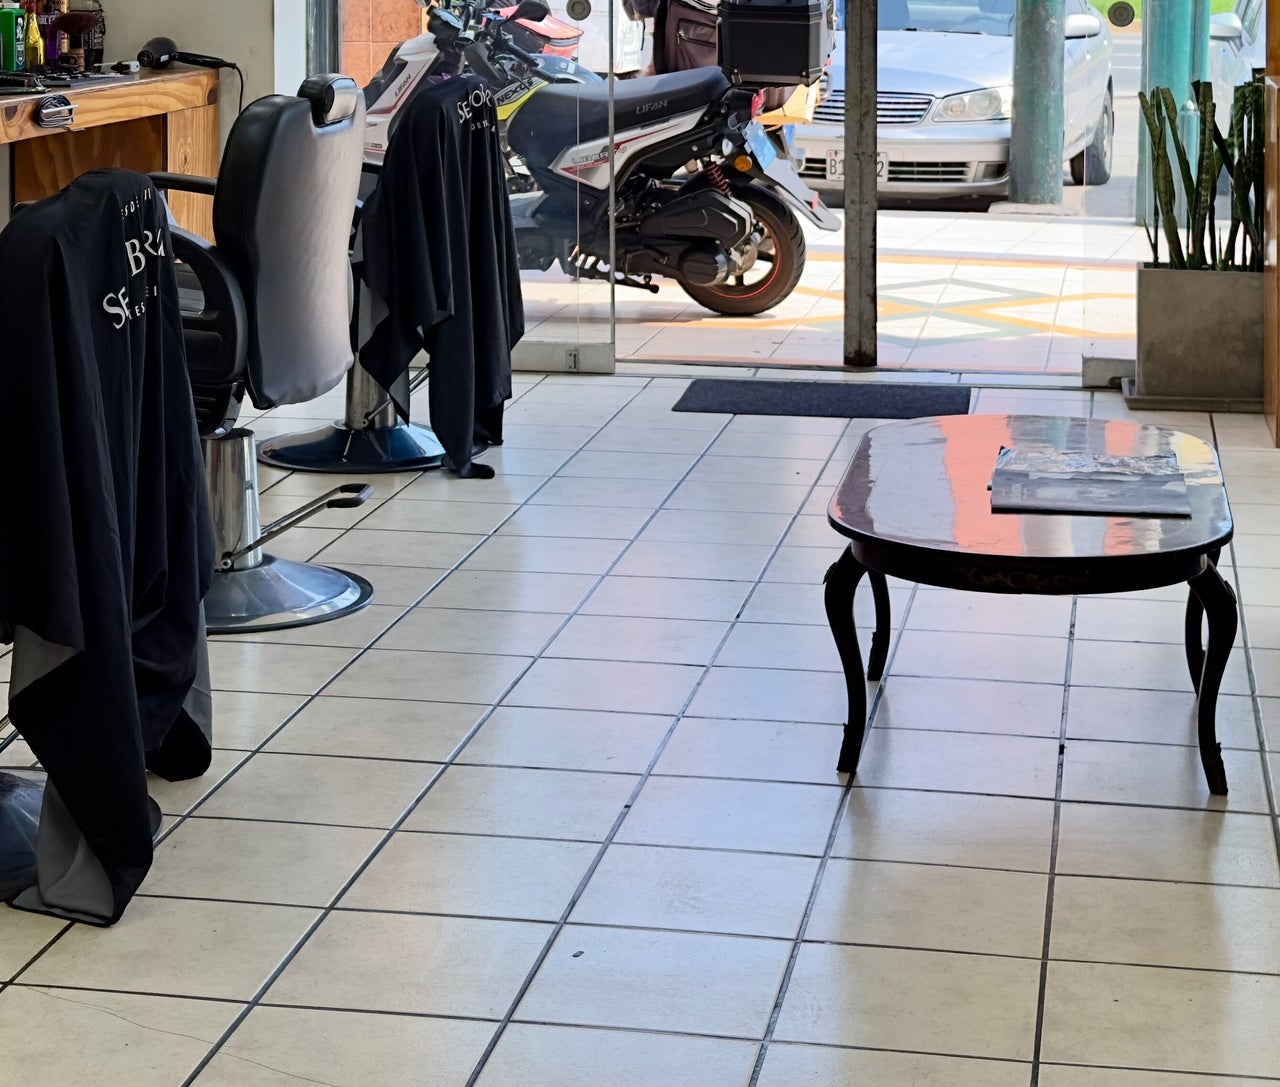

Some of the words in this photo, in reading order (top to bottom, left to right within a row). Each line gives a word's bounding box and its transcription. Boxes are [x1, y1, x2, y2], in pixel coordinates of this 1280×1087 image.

[394, 73, 412, 97] LIFAN
[635, 98, 669, 115] LIFAN
[571, 145, 627, 165] LIBERY
